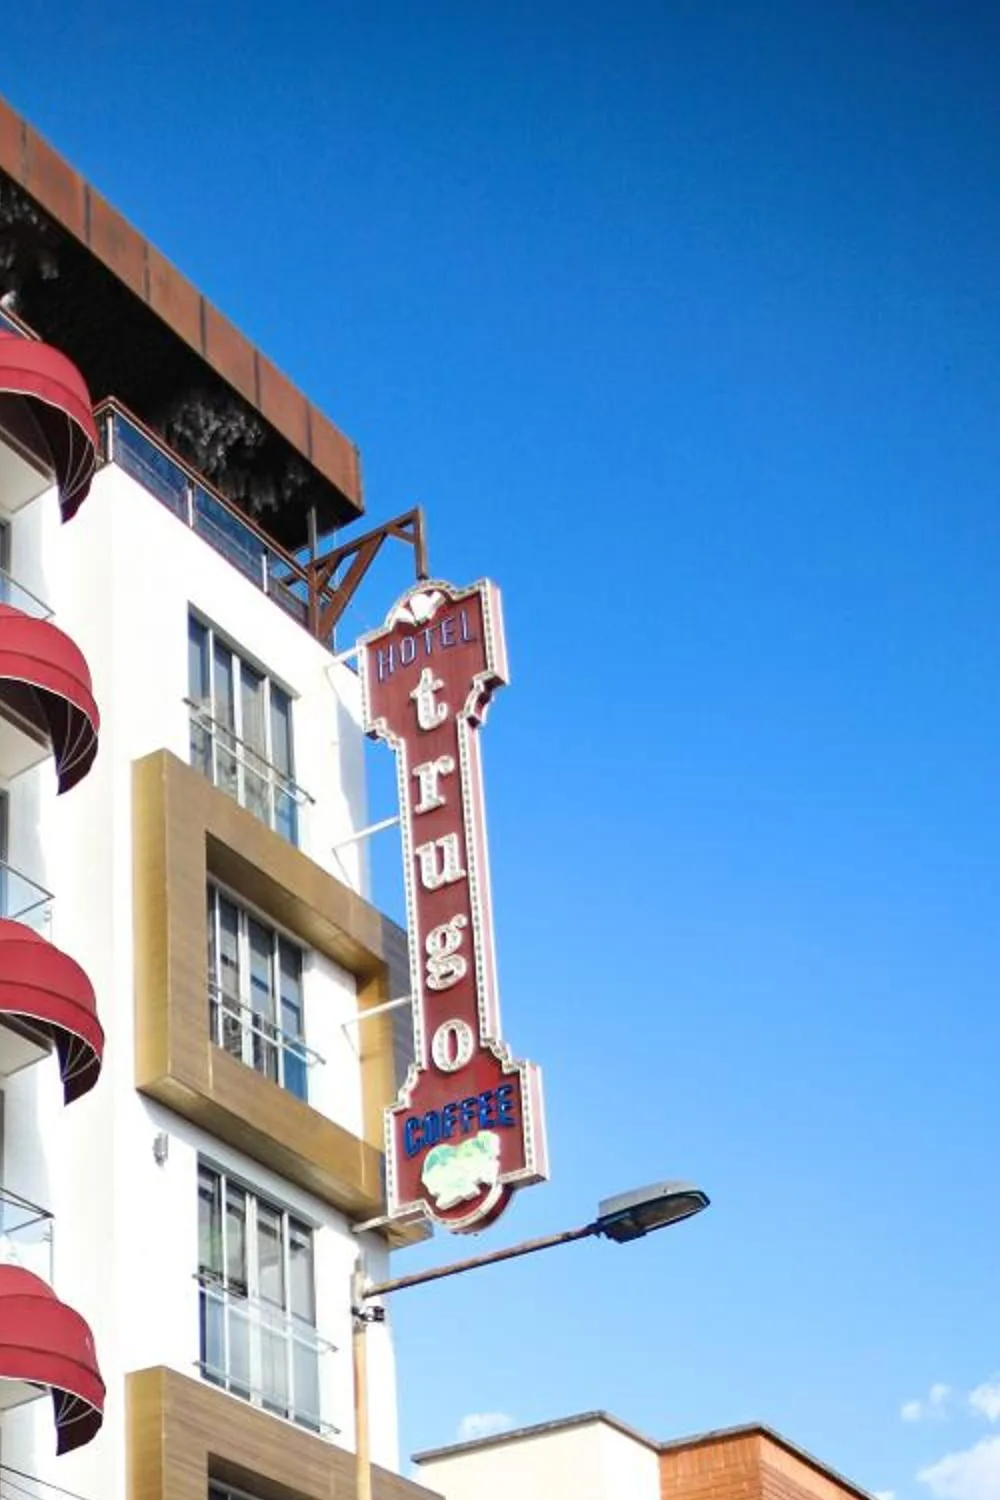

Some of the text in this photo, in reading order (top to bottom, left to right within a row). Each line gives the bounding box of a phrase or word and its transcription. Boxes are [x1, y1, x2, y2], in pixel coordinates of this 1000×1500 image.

[377, 609, 477, 681] HOTEL
[410, 666, 475, 1073] trugo
[404, 1084, 515, 1157] COFFEE
